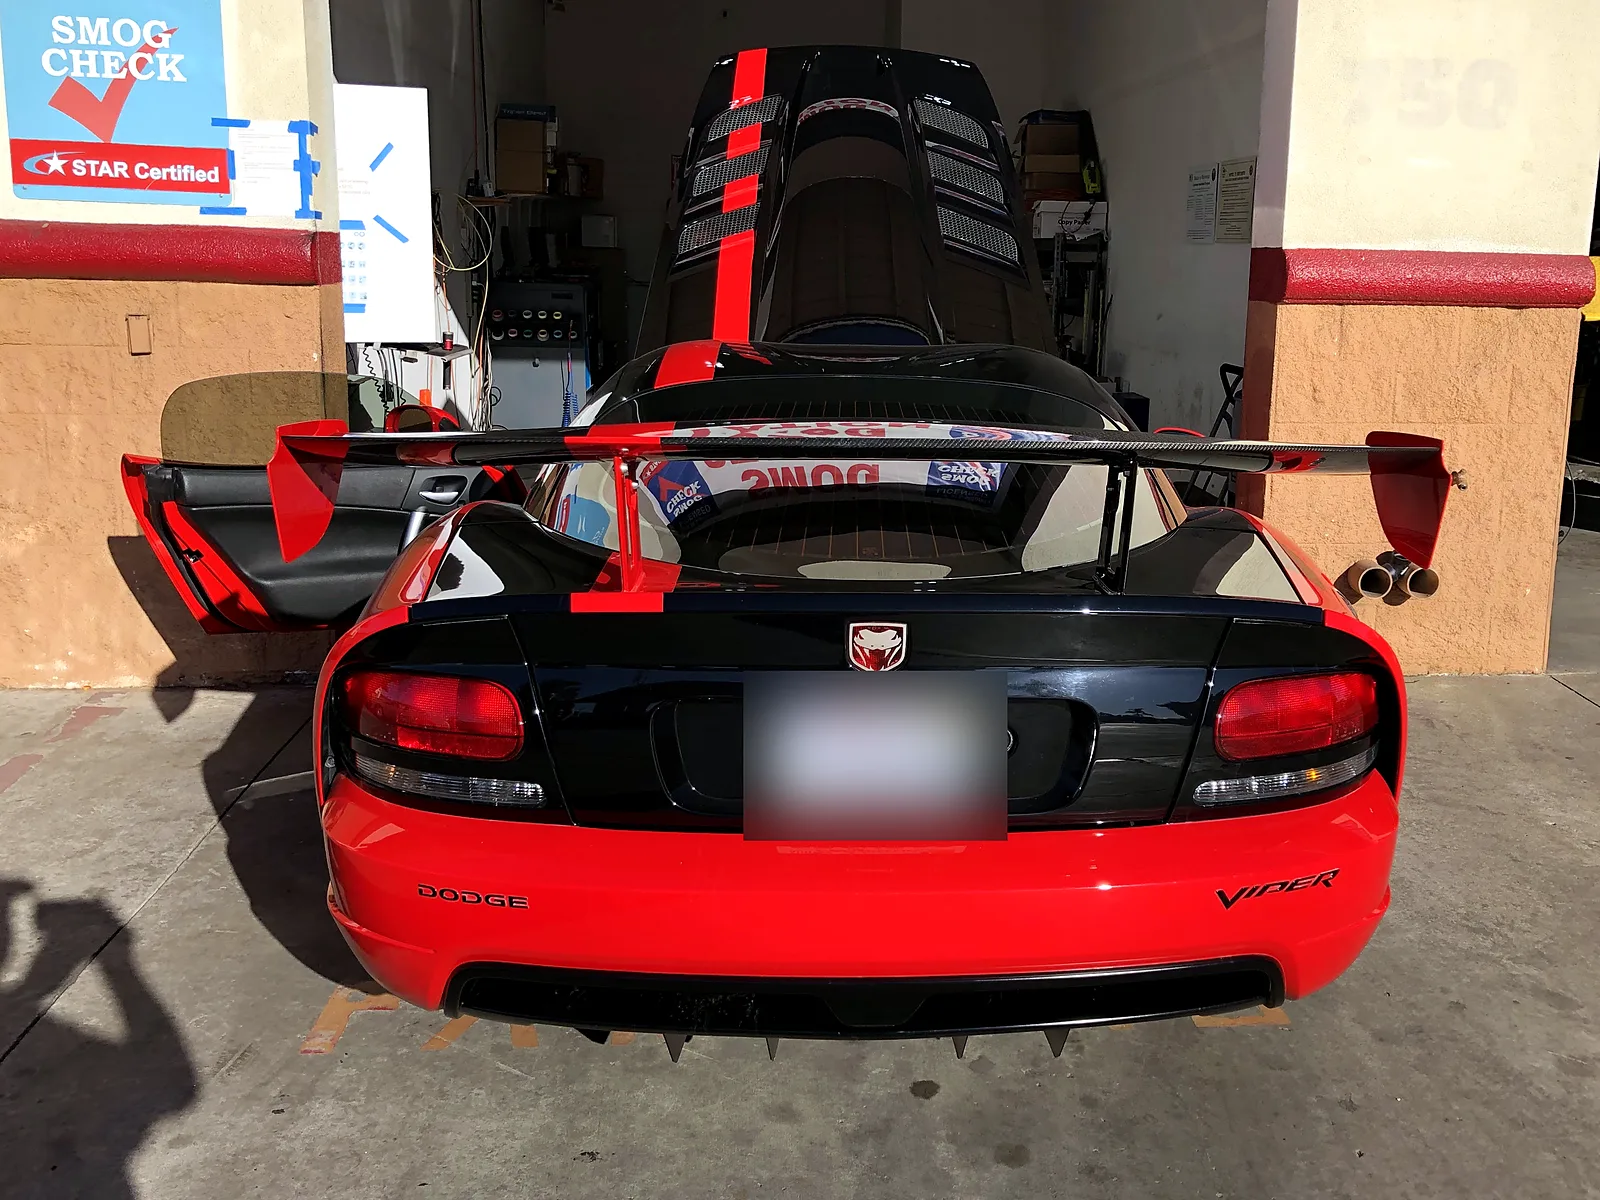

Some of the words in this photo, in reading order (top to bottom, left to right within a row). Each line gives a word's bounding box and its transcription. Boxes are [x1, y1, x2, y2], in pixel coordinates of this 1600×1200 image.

[51, 15, 172, 49] SMOG
[41, 47, 188, 83] CHECK
[72, 159, 130, 178] STAR
[134, 162, 220, 184] Certified
[417, 883, 530, 909] DODGE
[1214, 867, 1340, 910] VIPER
